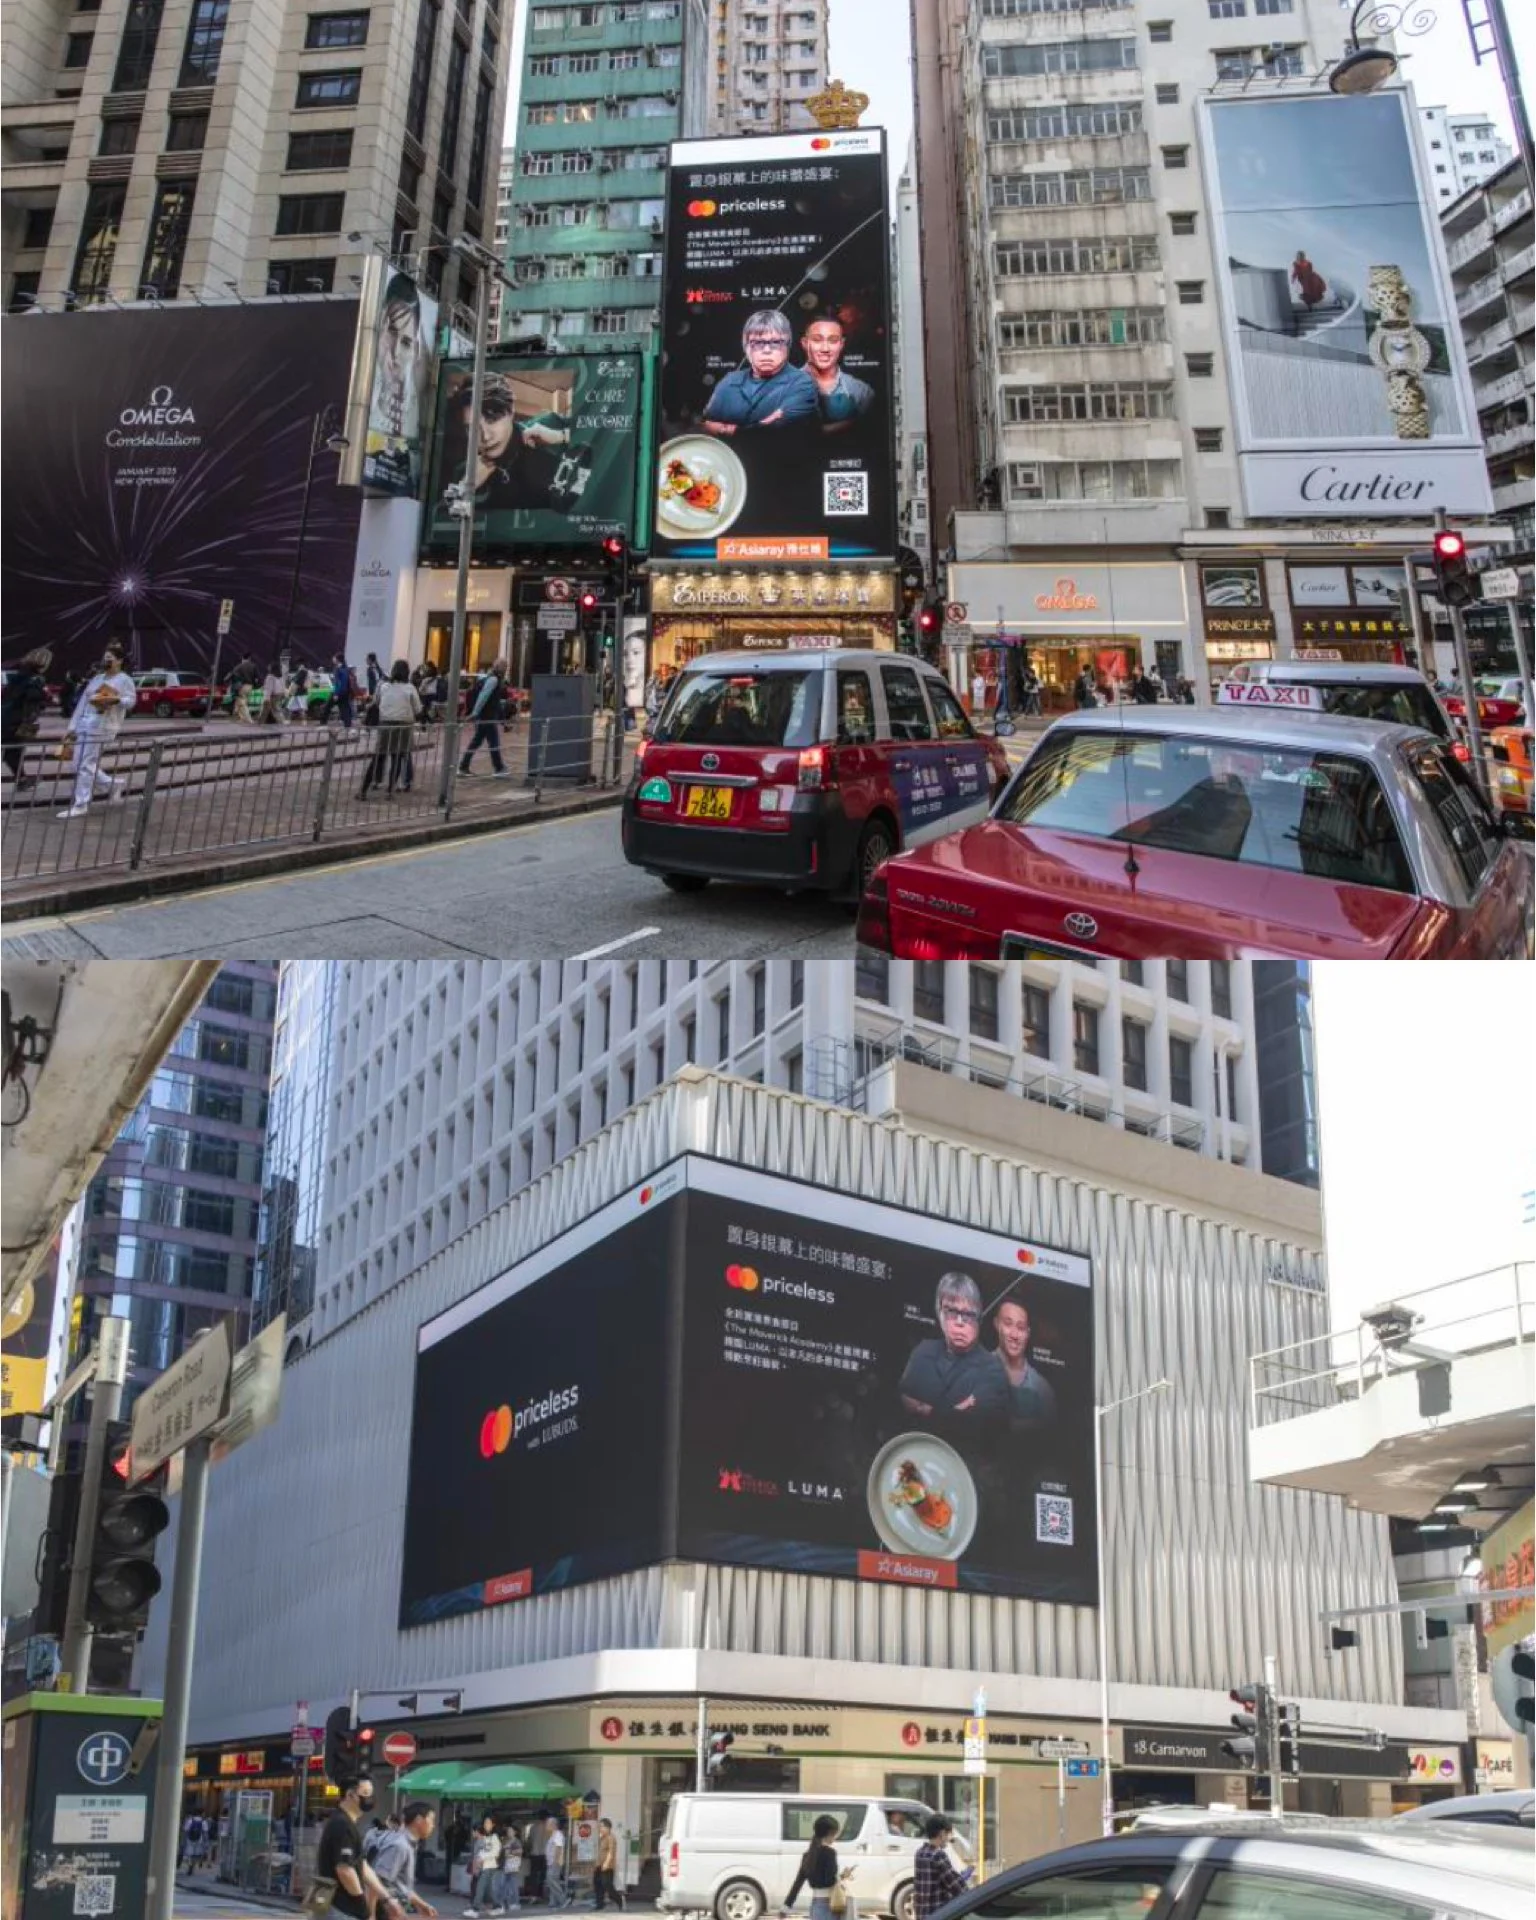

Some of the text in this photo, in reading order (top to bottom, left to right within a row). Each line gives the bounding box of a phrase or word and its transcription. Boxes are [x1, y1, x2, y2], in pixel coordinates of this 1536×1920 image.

[720, 197, 786, 215] priceless
[741, 286, 787, 297] LUMA
[585, 389, 626, 402] CORE
[120, 408, 195, 425] OMEGA
[576, 414, 633, 428] ENCORE
[106, 429, 201, 448] Constellation
[117, 467, 154, 476] JANUARY
[115, 476, 175, 486] NEW OPENING
[1300, 465, 1434, 501] Cartier
[740, 542, 784, 558] Asiaray
[360, 568, 391, 578] OMEGA
[1300, 581, 1339, 593] Cartier
[1035, 593, 1097, 609] OMEGA
[1207, 619, 1252, 631] PRINCE
[795, 635, 832, 648] TAXI
[1294, 650, 1338, 659] TAXI
[1225, 684, 1309, 705] TAXI
[691, 800, 726, 817] 7846
[763, 1276, 835, 1304] priceless
[514, 1384, 579, 1438] priceless
[788, 1480, 843, 1500] LUMA
[893, 1561, 938, 1584] Asiaray
[711, 1722, 749, 1736] HANG
[752, 1723, 789, 1737] SENG
[793, 1723, 830, 1737] BANK
[1134, 1739, 1207, 1758] 18 Carnarvon
